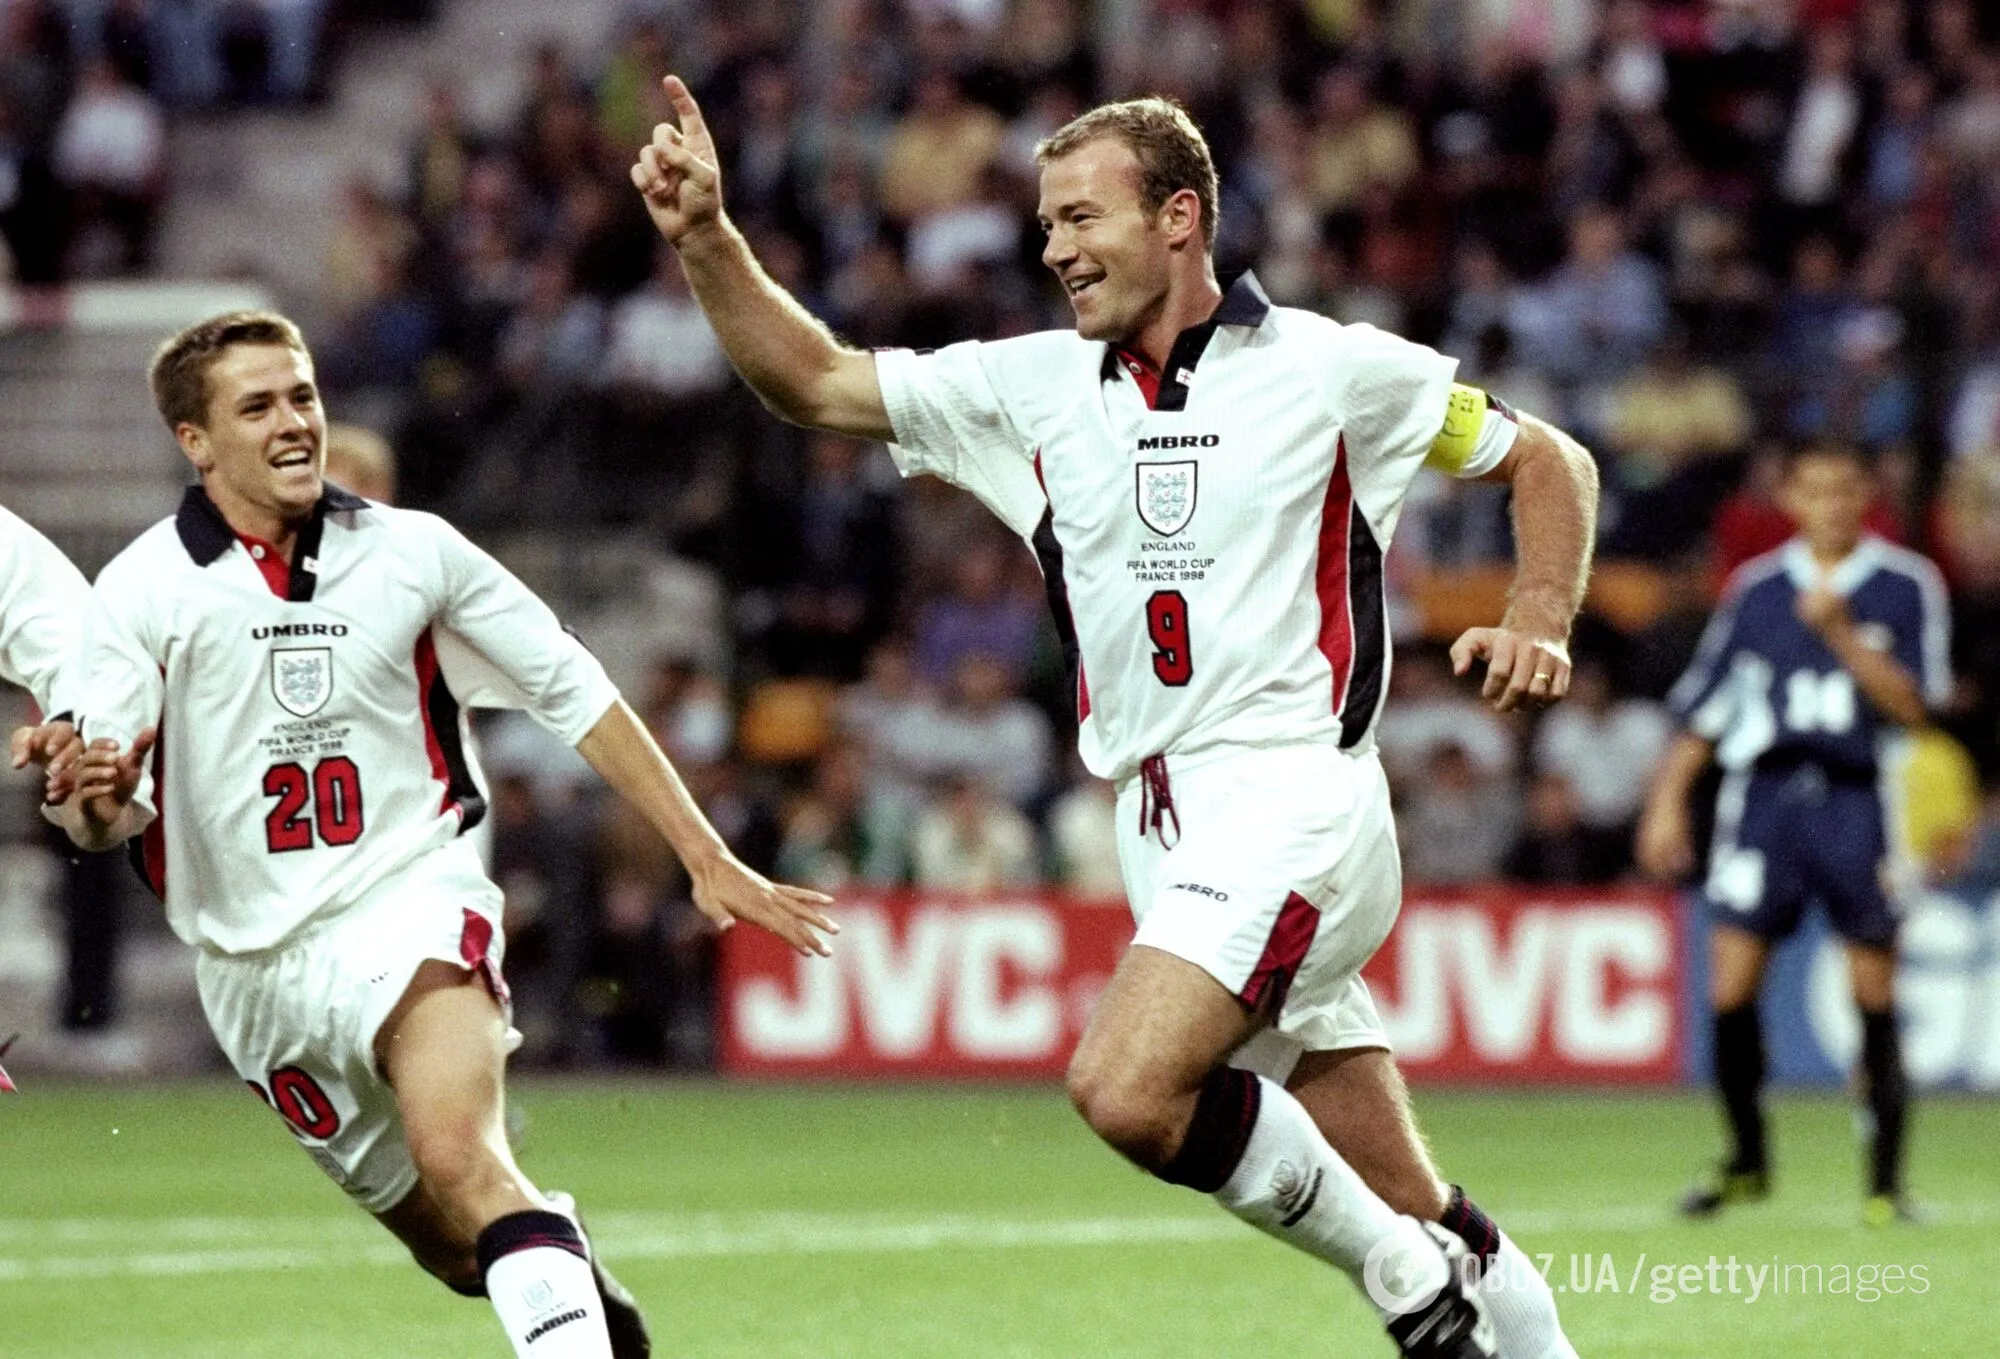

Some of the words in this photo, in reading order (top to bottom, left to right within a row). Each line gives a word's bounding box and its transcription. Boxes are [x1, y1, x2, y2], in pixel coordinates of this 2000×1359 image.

[1137, 434, 1220, 450] MBRO
[1141, 541, 1196, 552] ENGLAND
[1126, 560, 1147, 570] FIFA
[1150, 559, 1188, 570] WORLD
[1190, 558, 1215, 569] CUP
[1135, 571, 1176, 582] FRANCE
[1179, 570, 1205, 581] 1998
[252, 624, 348, 640] UMBRO
[1146, 590, 1193, 687] 9
[328, 727, 351, 739] CUP
[262, 755, 365, 854] 20
[736, 906, 1062, 1058] JVC
[1374, 906, 1668, 1062] JVC
[247, 1066, 341, 1141] 0
[525, 1308, 588, 1345] UMBRO
